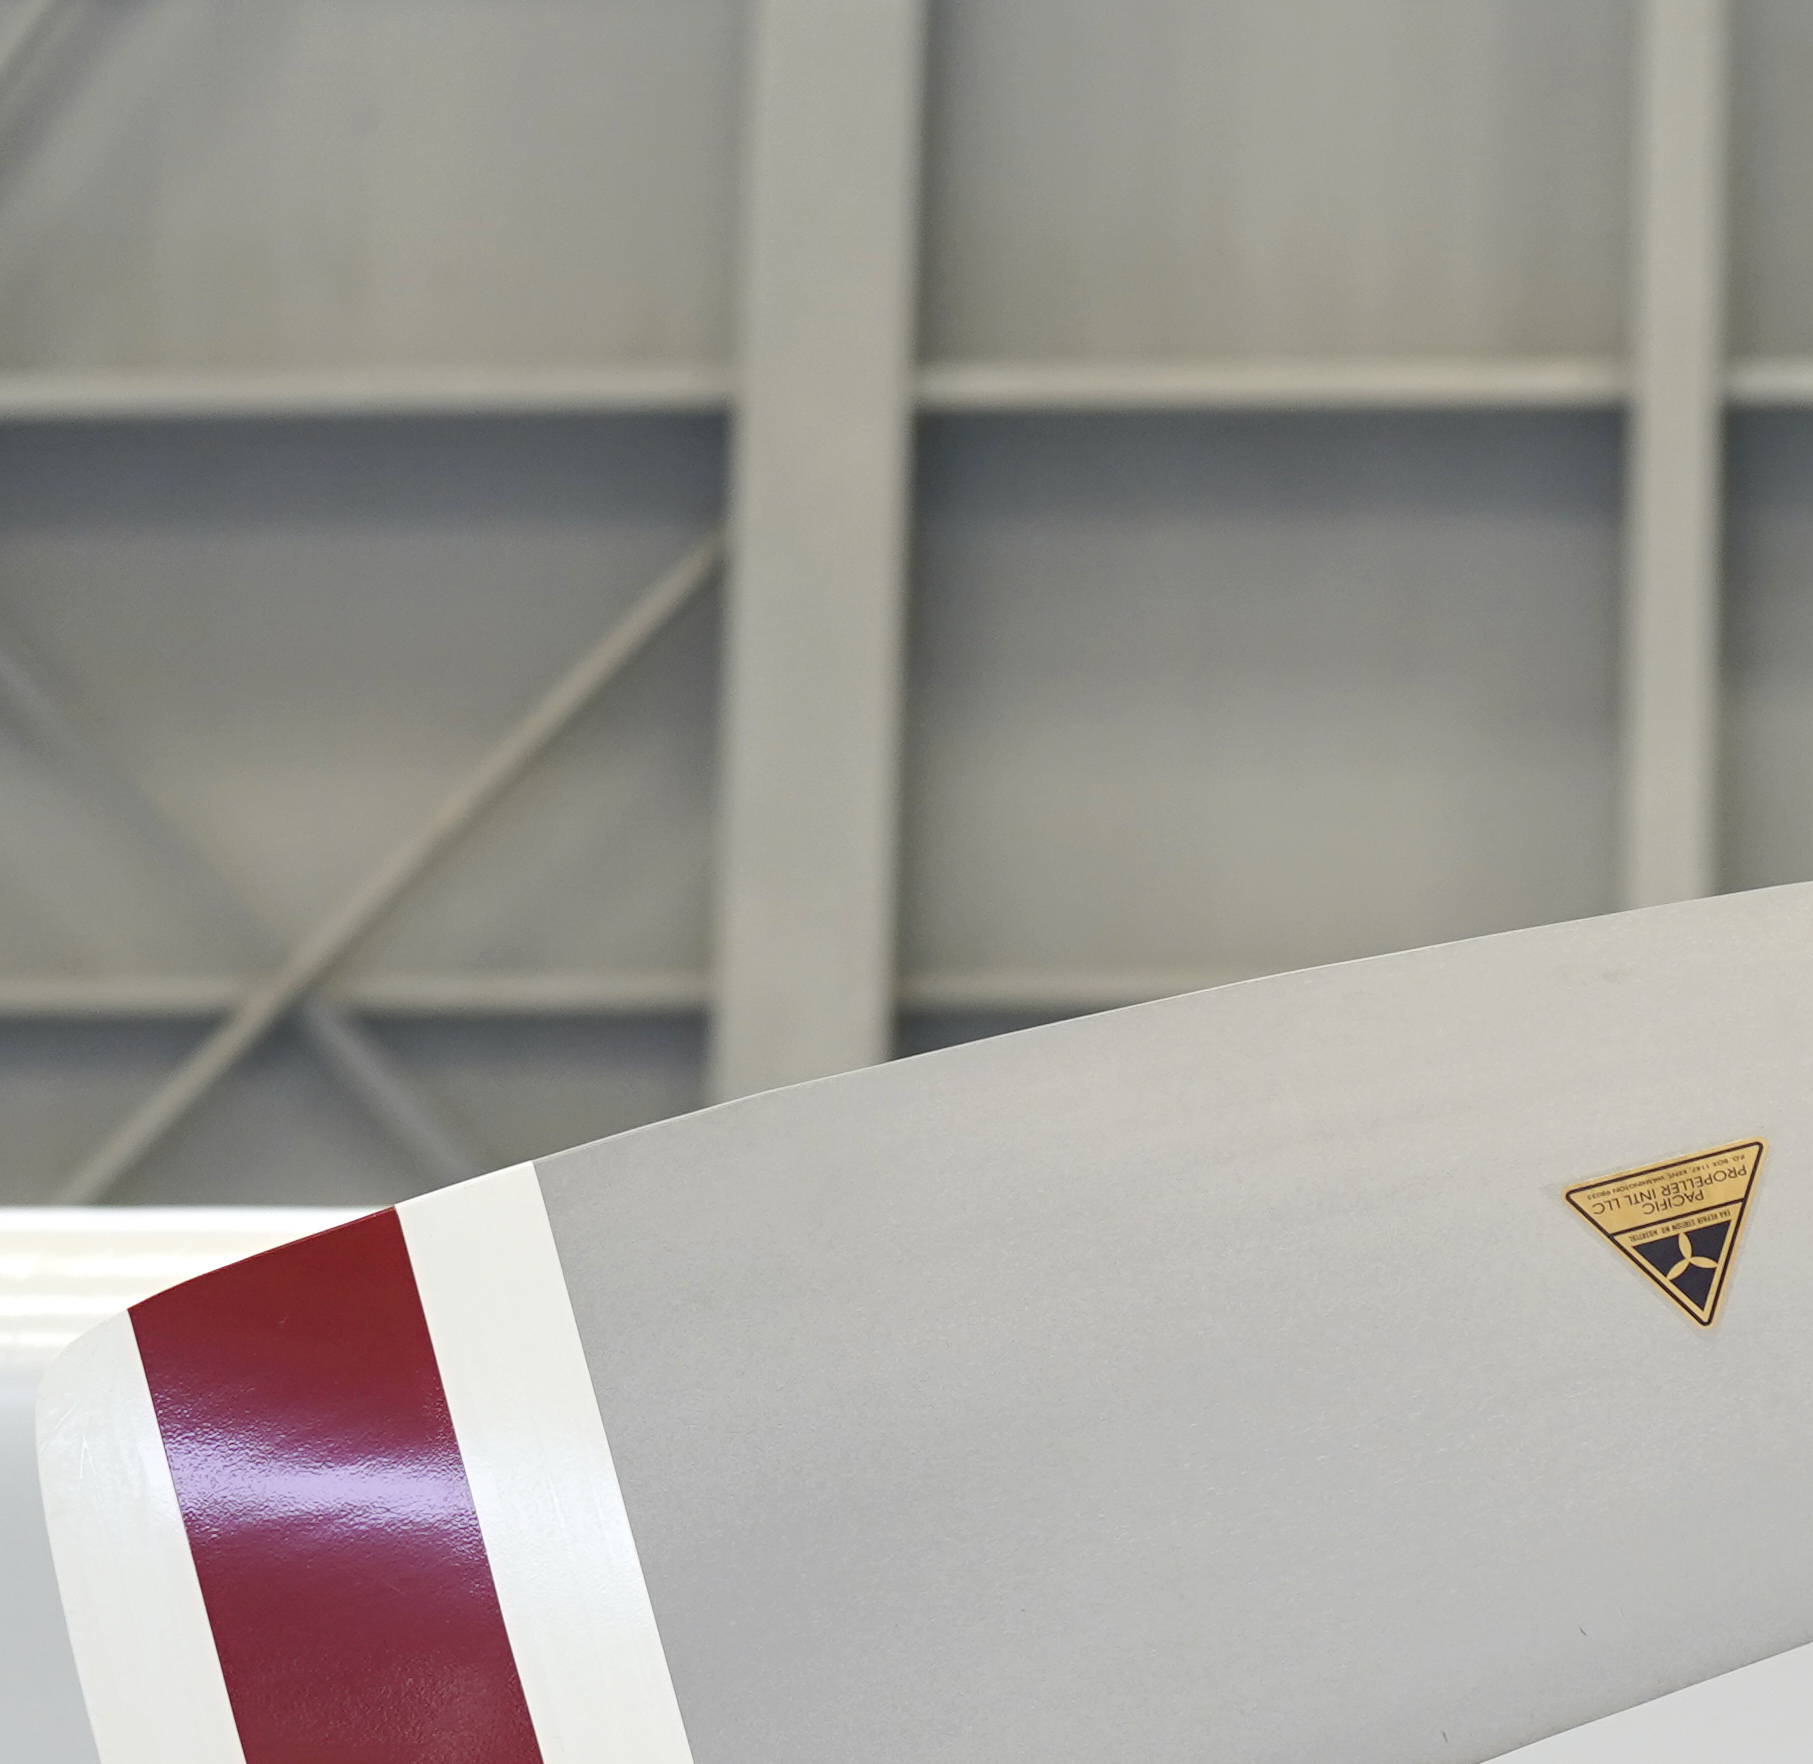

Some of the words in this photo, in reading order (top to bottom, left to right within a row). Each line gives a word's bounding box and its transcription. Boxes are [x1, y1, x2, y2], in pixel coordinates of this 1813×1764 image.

[1711, 1157, 1728, 1166] BOX
[1610, 1176, 1665, 1194] WASHINGTON
[1659, 1165, 1747, 1196] PROPELLER
[1623, 1188, 1657, 1205] INTL
[1643, 1189, 1704, 1215] PACIFIC
[1592, 1199, 1620, 1215] LLC
